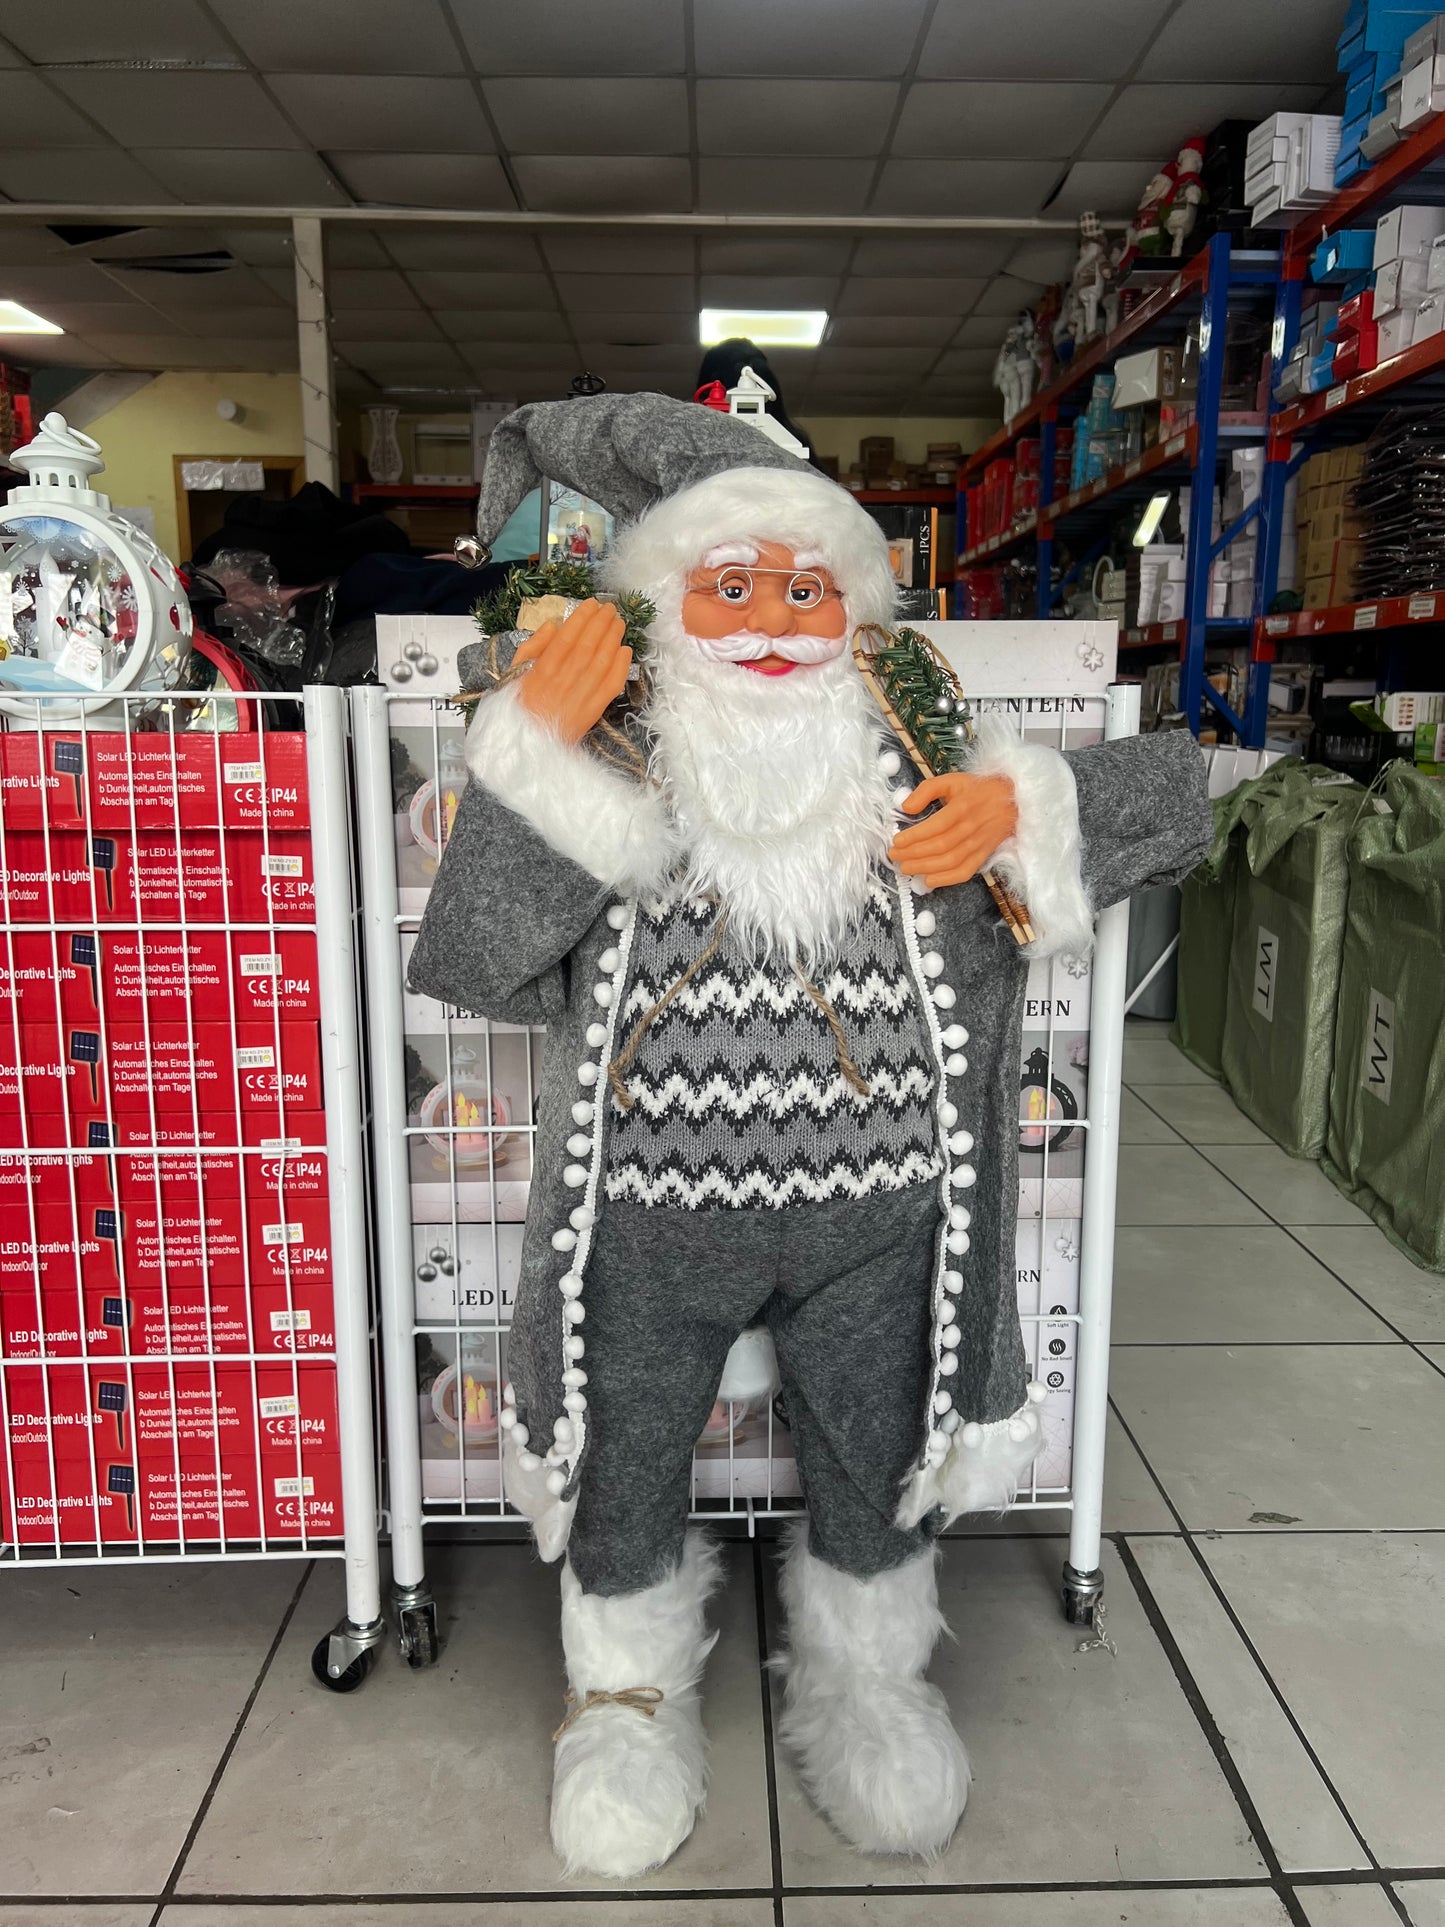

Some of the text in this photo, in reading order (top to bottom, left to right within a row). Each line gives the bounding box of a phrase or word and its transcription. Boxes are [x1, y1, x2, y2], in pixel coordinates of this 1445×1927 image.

[920, 525, 930, 554] 1PCS
[97, 752, 117, 762] Solar
[234, 788, 298, 803] CE IP44
[145, 798, 158, 806] am
[272, 808, 295, 817] china
[149, 848, 167, 857] LED
[62, 869, 91, 885] Lights
[187, 890, 207, 901] Tage
[290, 901, 297, 910] in
[113, 945, 133, 954] Solar
[1257, 941, 1273, 1009] WT
[248, 979, 311, 994] CE IP44
[285, 998, 307, 1007] china
[112, 1041, 133, 1051] Solar
[1368, 1003, 1391, 1084] WT
[245, 1074, 308, 1089] CE IP44
[172, 1082, 192, 1094] Tage
[250, 1093, 273, 1102] Made
[283, 1093, 304, 1101] china
[129, 1132, 150, 1141] Solar
[296, 1162, 322, 1177] IP44
[289, 1181, 297, 1189] in
[297, 1181, 319, 1189] china
[136, 1219, 156, 1228] Solar
[1, 1242, 20, 1254] LED
[302, 1247, 328, 1262] IP44
[304, 1266, 325, 1274] china
[452, 1289, 495, 1306] LED
[143, 1306, 164, 1315] Solar
[9, 1331, 29, 1343] LED
[308, 1333, 334, 1347] IP44
[138, 1391, 158, 1400] Solar
[266, 1419, 326, 1434] CE IP44
[271, 1437, 323, 1446] Made china
[148, 1473, 168, 1483] Solar
[16, 1497, 35, 1509] LED
[275, 1501, 334, 1516] CE IP44
[310, 1519, 331, 1527] china
